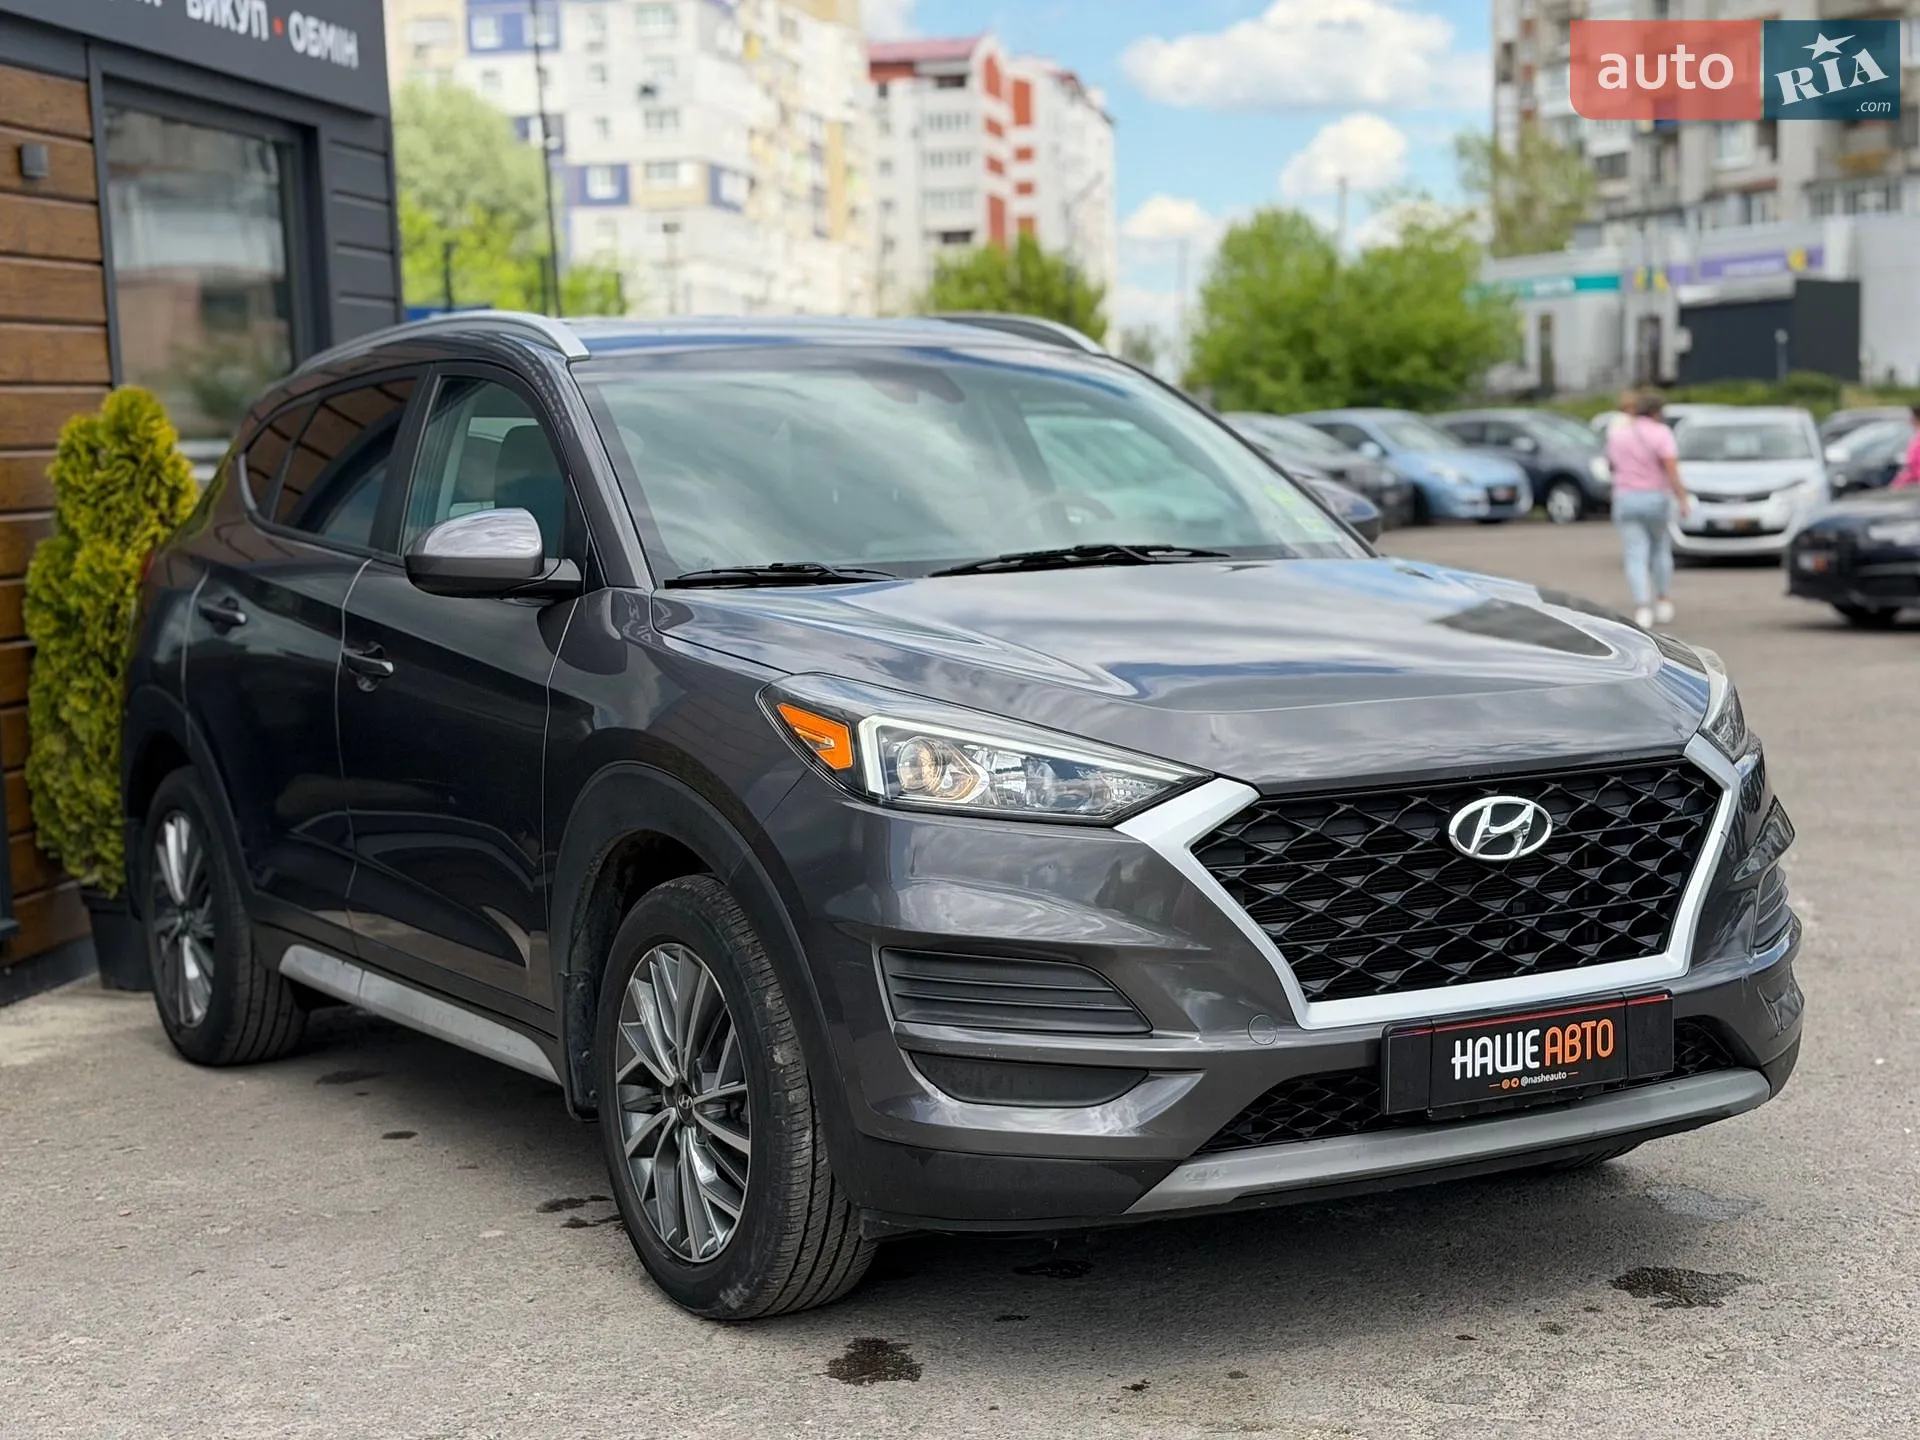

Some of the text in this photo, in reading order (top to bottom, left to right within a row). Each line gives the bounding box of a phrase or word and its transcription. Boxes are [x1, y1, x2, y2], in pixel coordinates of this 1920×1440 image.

[287, 10, 359, 70] ОБМІН
[1451, 1018, 1614, 1080] НАШЕ АВТО
[1520, 1071, 1567, 1087] @nasheauto
